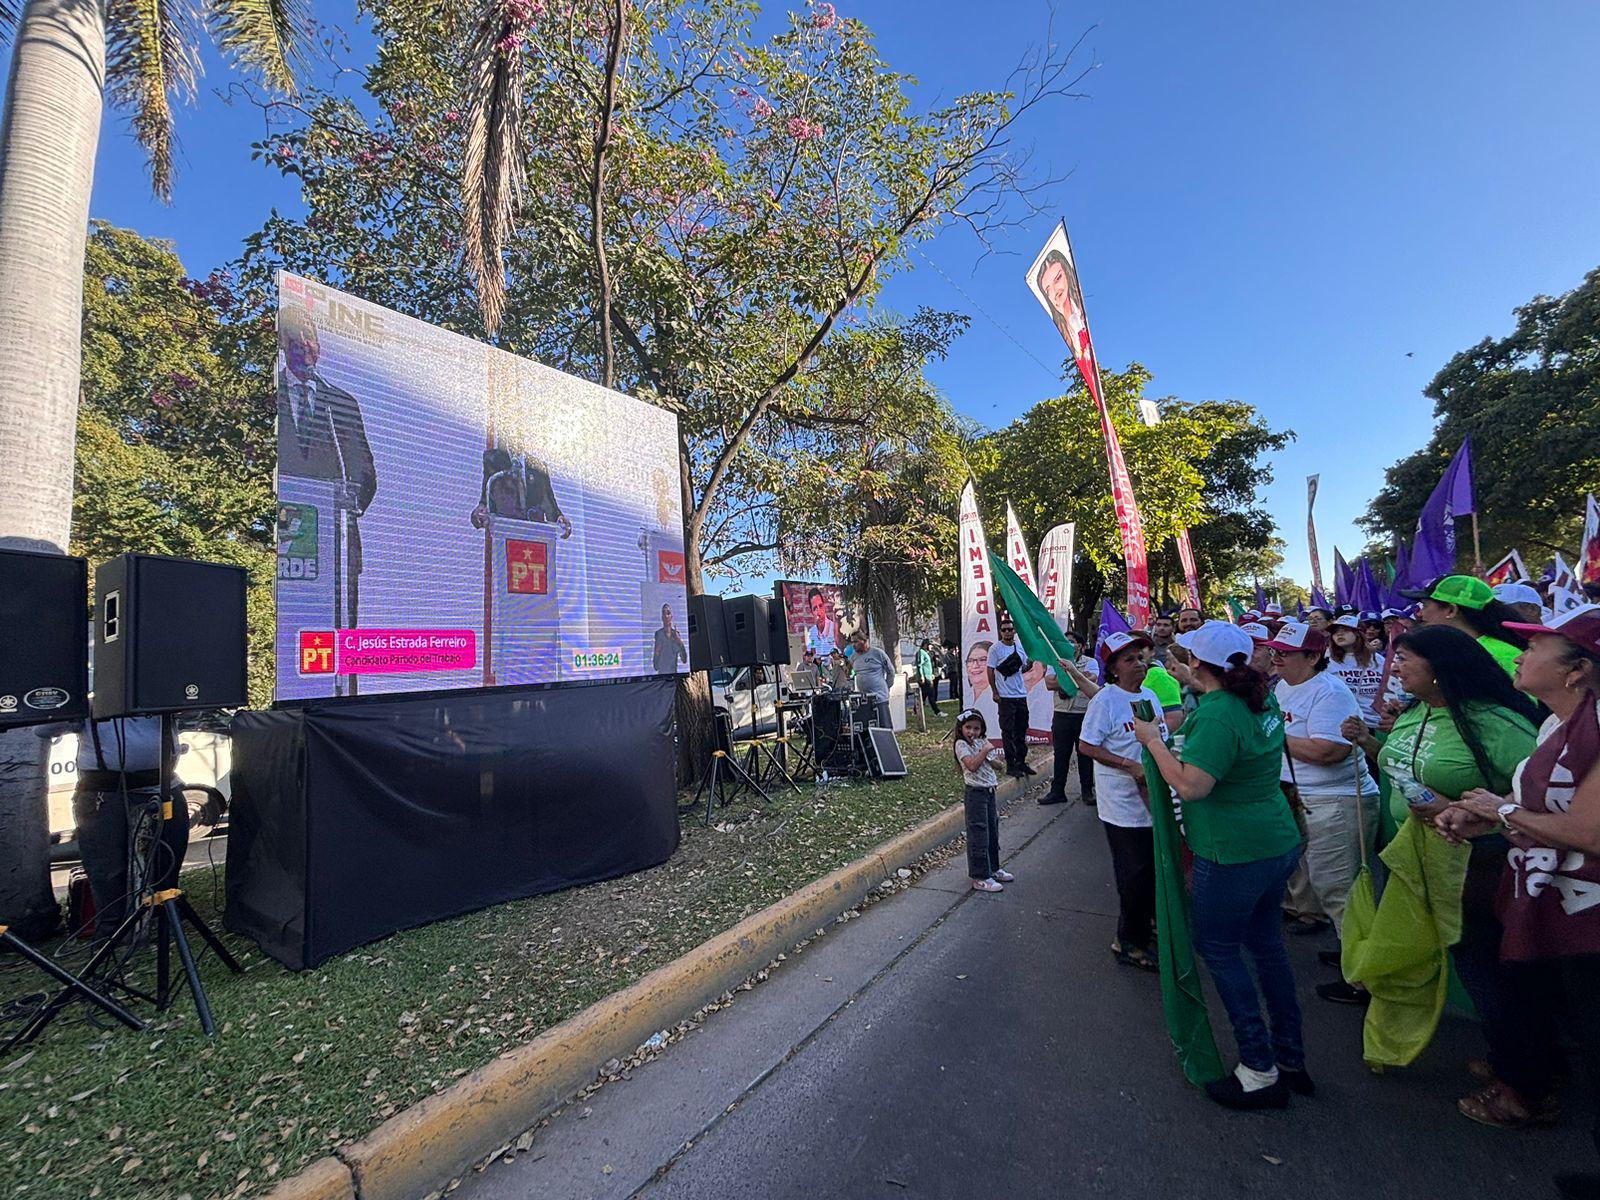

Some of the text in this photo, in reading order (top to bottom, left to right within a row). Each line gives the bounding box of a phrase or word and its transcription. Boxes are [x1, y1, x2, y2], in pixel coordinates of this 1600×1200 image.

[329, 300, 385, 336] INE
[512, 561, 546, 590] PT
[345, 635, 467, 651] C. Jesús Estrada Ferreiro
[303, 647, 331, 670] PT
[575, 652, 620, 667] 01:36:24
